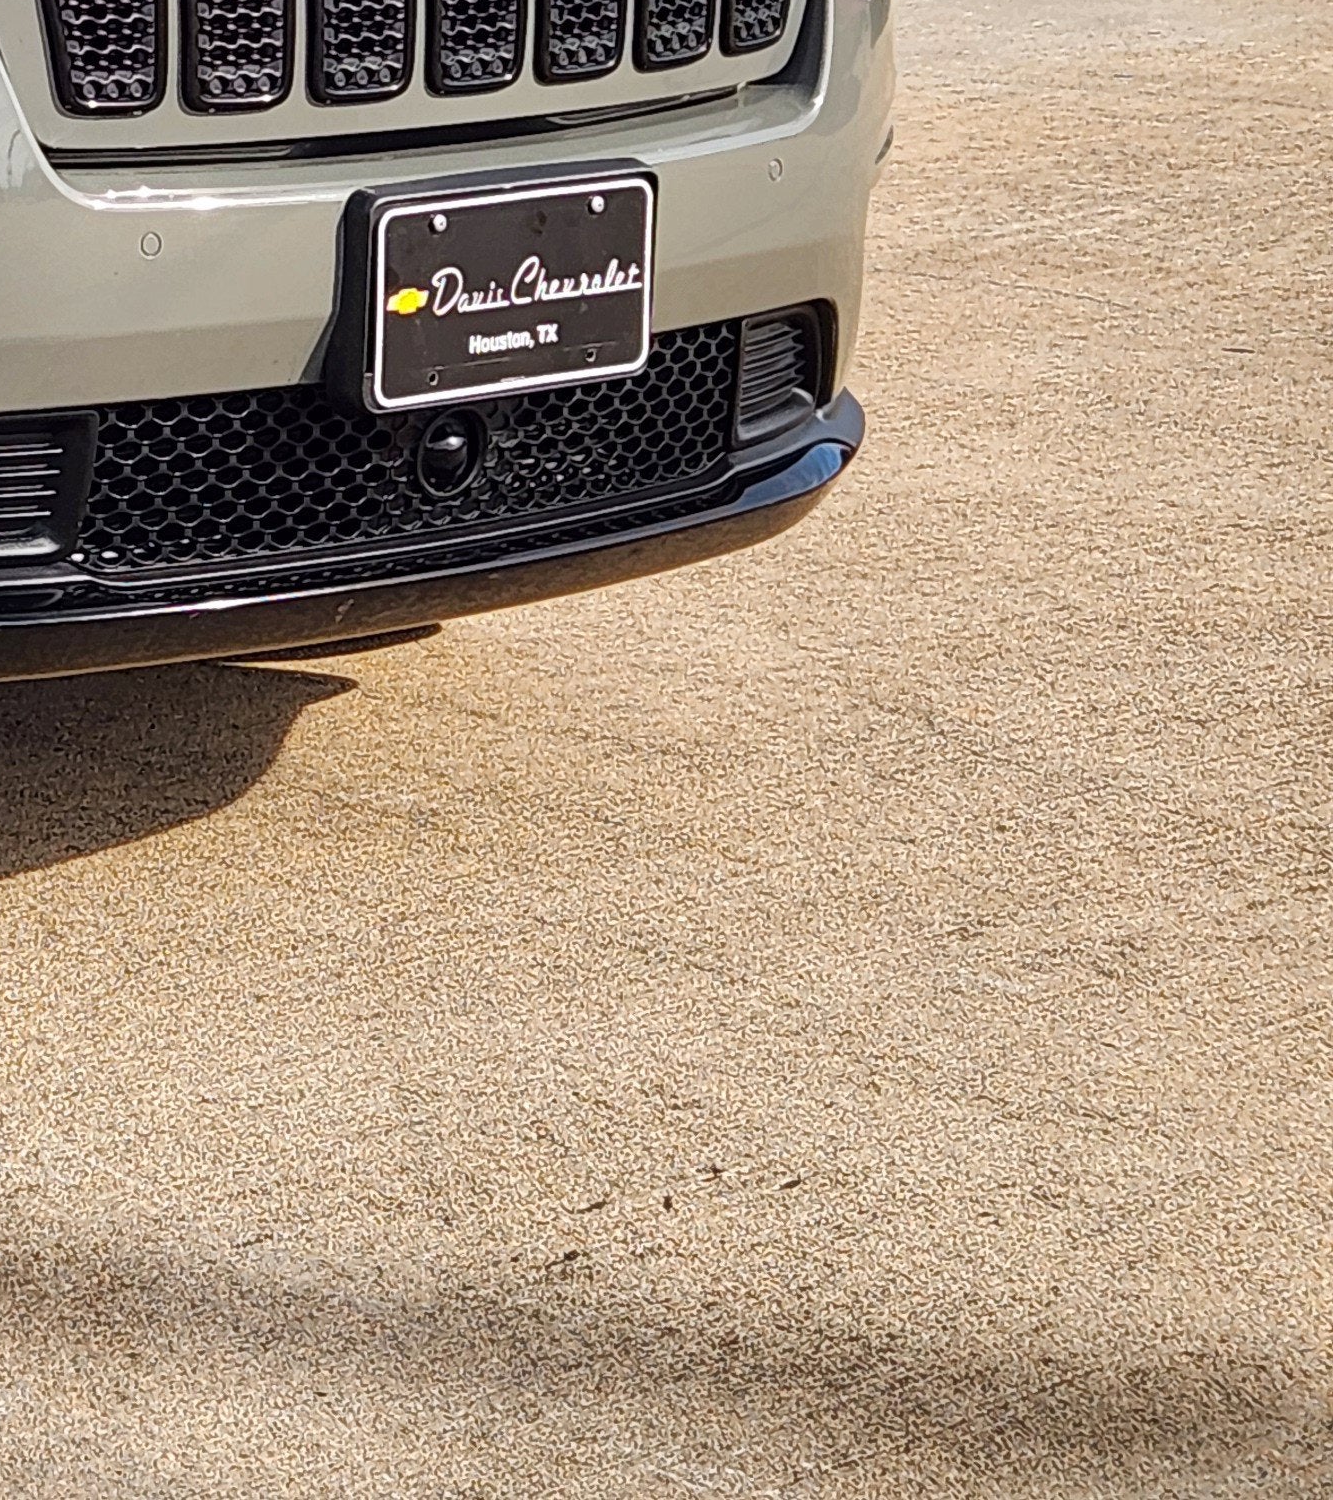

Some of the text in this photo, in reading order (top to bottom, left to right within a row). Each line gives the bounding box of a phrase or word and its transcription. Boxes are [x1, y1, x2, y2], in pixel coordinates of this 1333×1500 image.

[431, 255, 643, 316] Davis Chevrolet
[468, 323, 559, 355] Houston, TX
